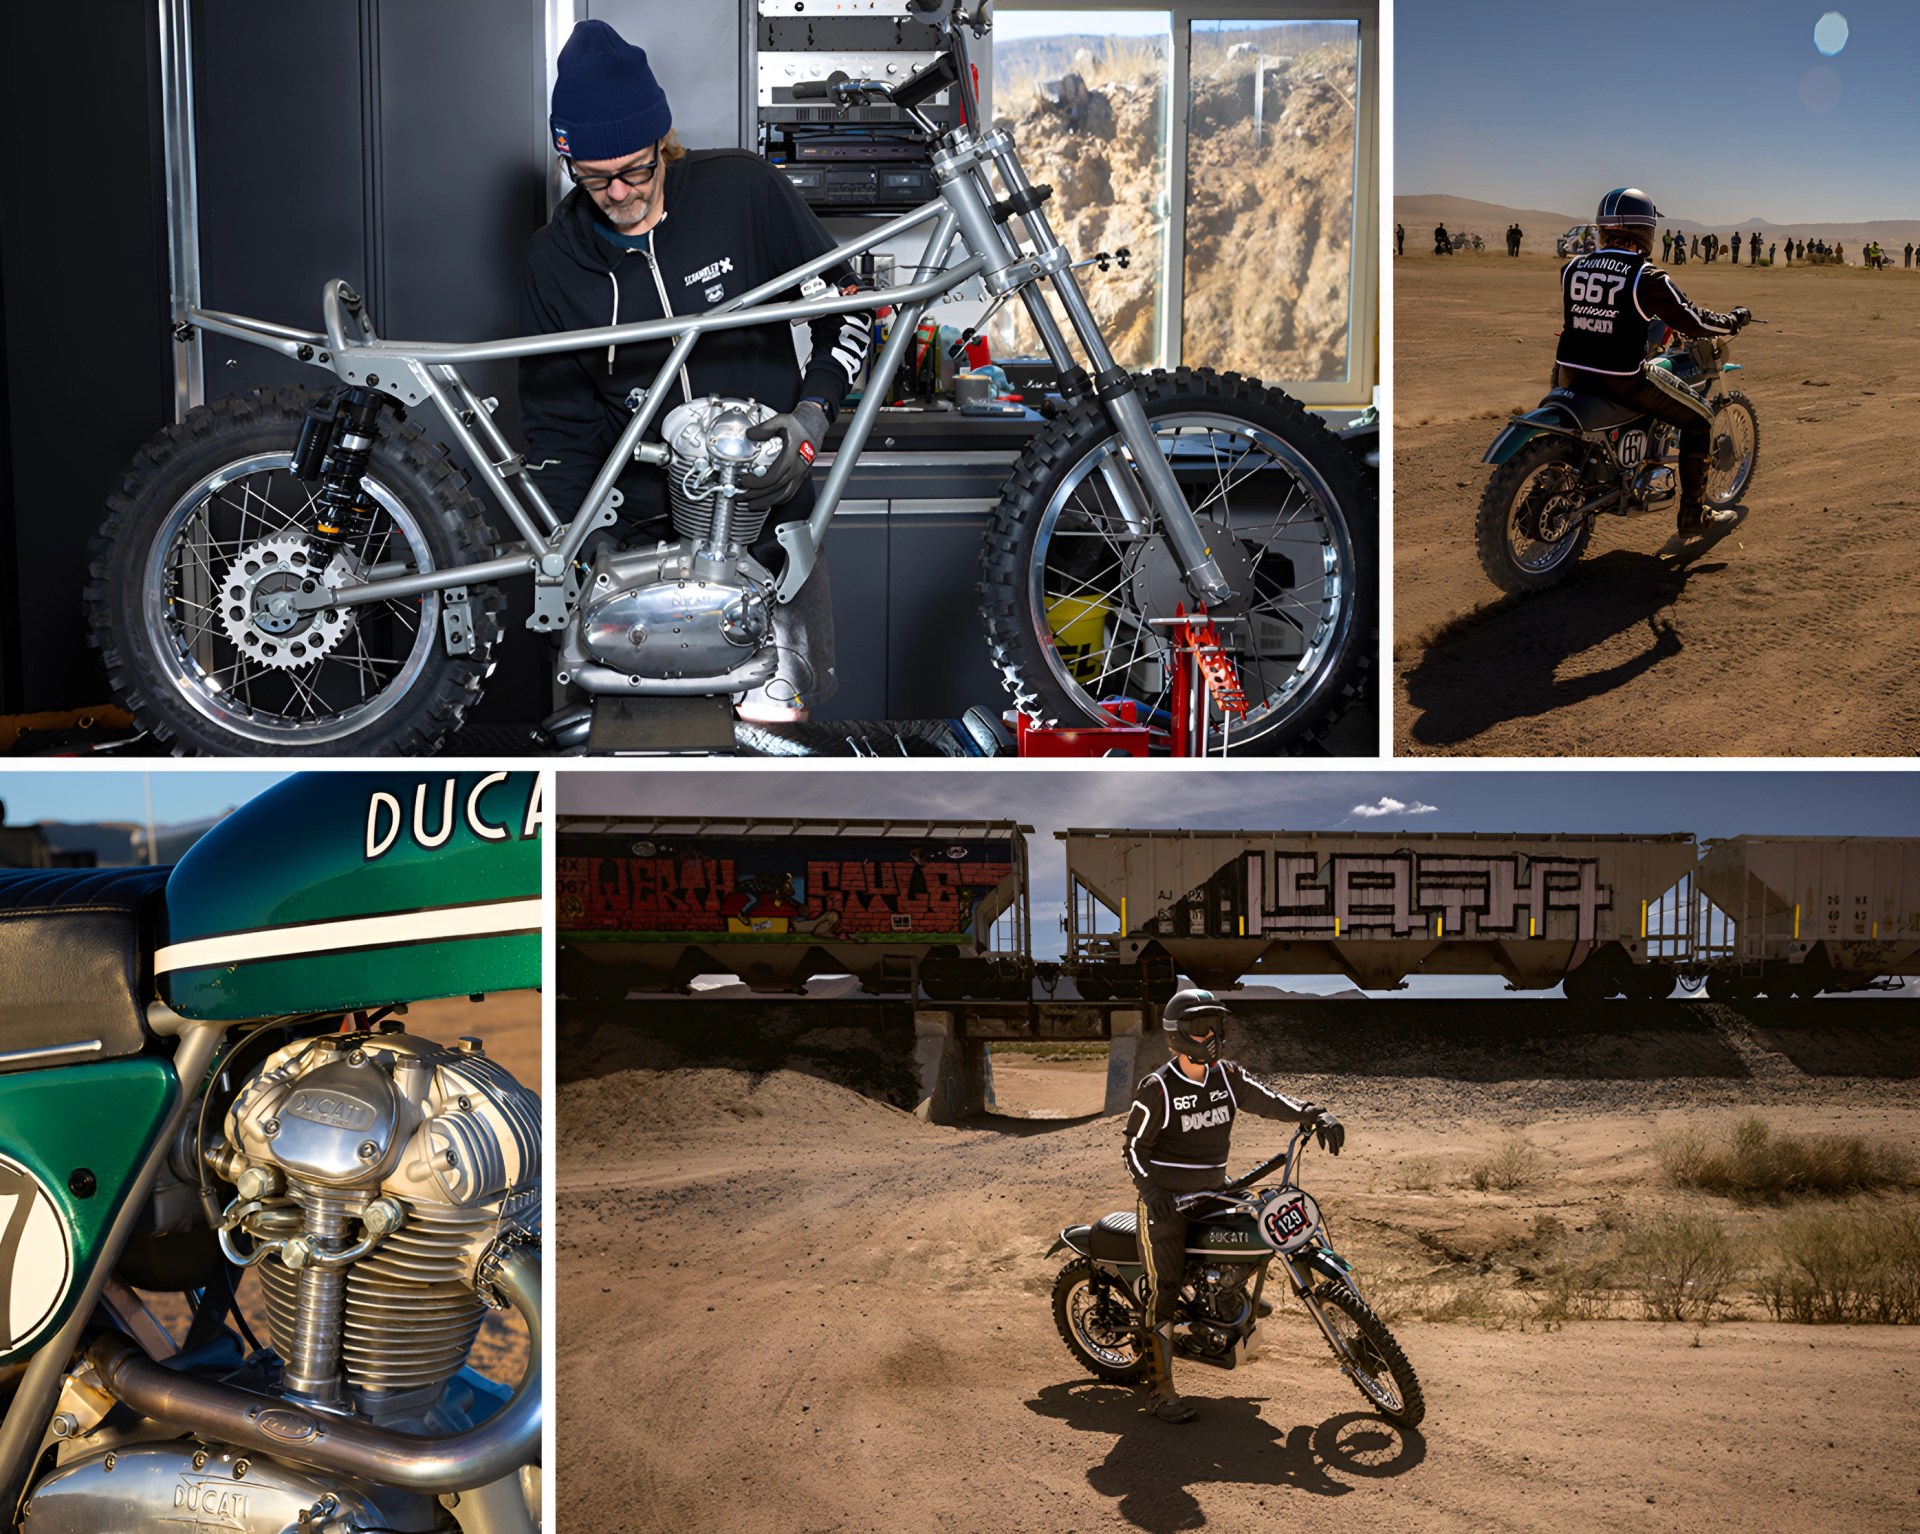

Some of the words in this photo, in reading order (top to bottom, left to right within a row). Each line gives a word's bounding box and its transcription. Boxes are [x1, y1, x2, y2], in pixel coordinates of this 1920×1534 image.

[1570, 270, 1627, 306] 667
[1572, 315, 1614, 334] DUCATI
[295, 1094, 366, 1126] DUCATI
[1173, 1094, 1198, 1111] 667
[1180, 1105, 1231, 1133] DUCATI
[1278, 1209, 1302, 1234] 129
[174, 1484, 249, 1519] DUCATI
